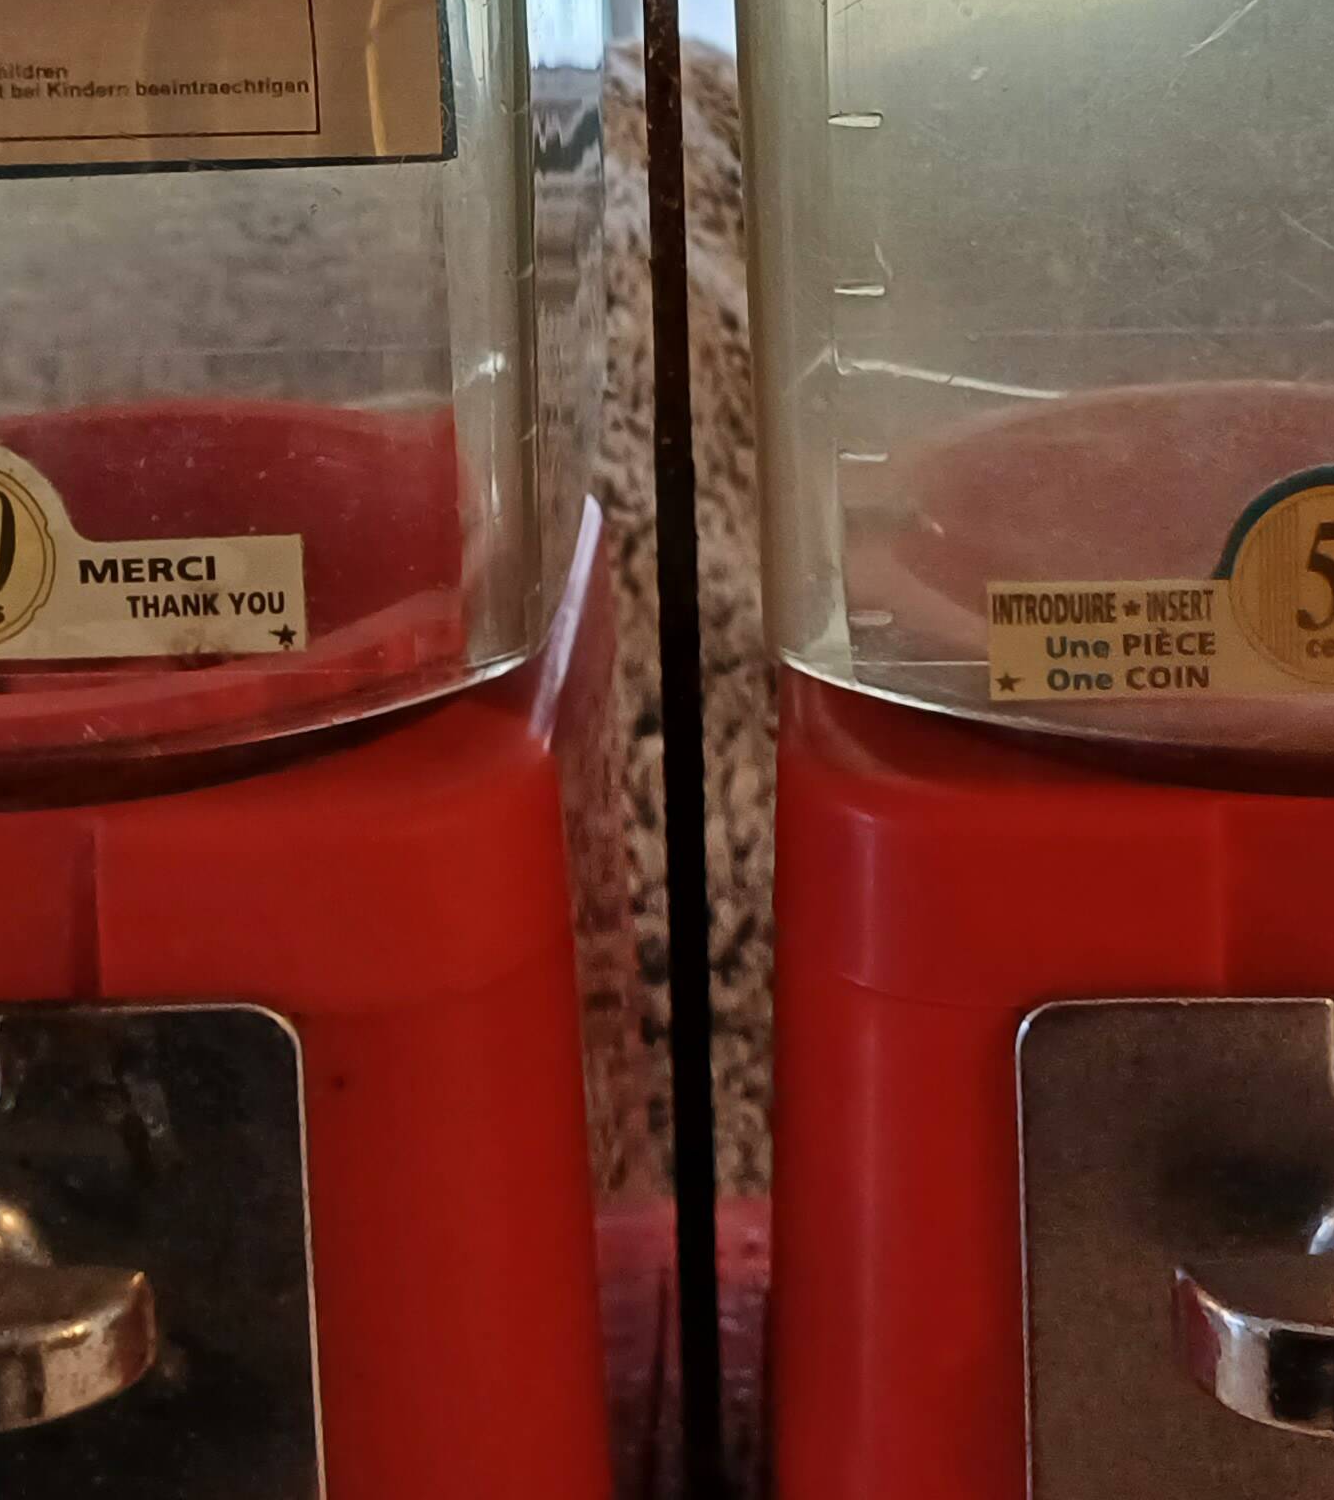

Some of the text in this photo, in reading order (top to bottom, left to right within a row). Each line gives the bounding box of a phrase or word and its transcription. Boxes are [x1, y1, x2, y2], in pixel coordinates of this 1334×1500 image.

[47, 81, 130, 100] Kindern
[78, 554, 216, 585] MERCI
[125, 590, 287, 620] THANK YOU
[992, 588, 1214, 626] INTRODUIRE INSERT
[1045, 626, 1217, 661] Une PIÈCE
[1045, 664, 1211, 693] One COIN
